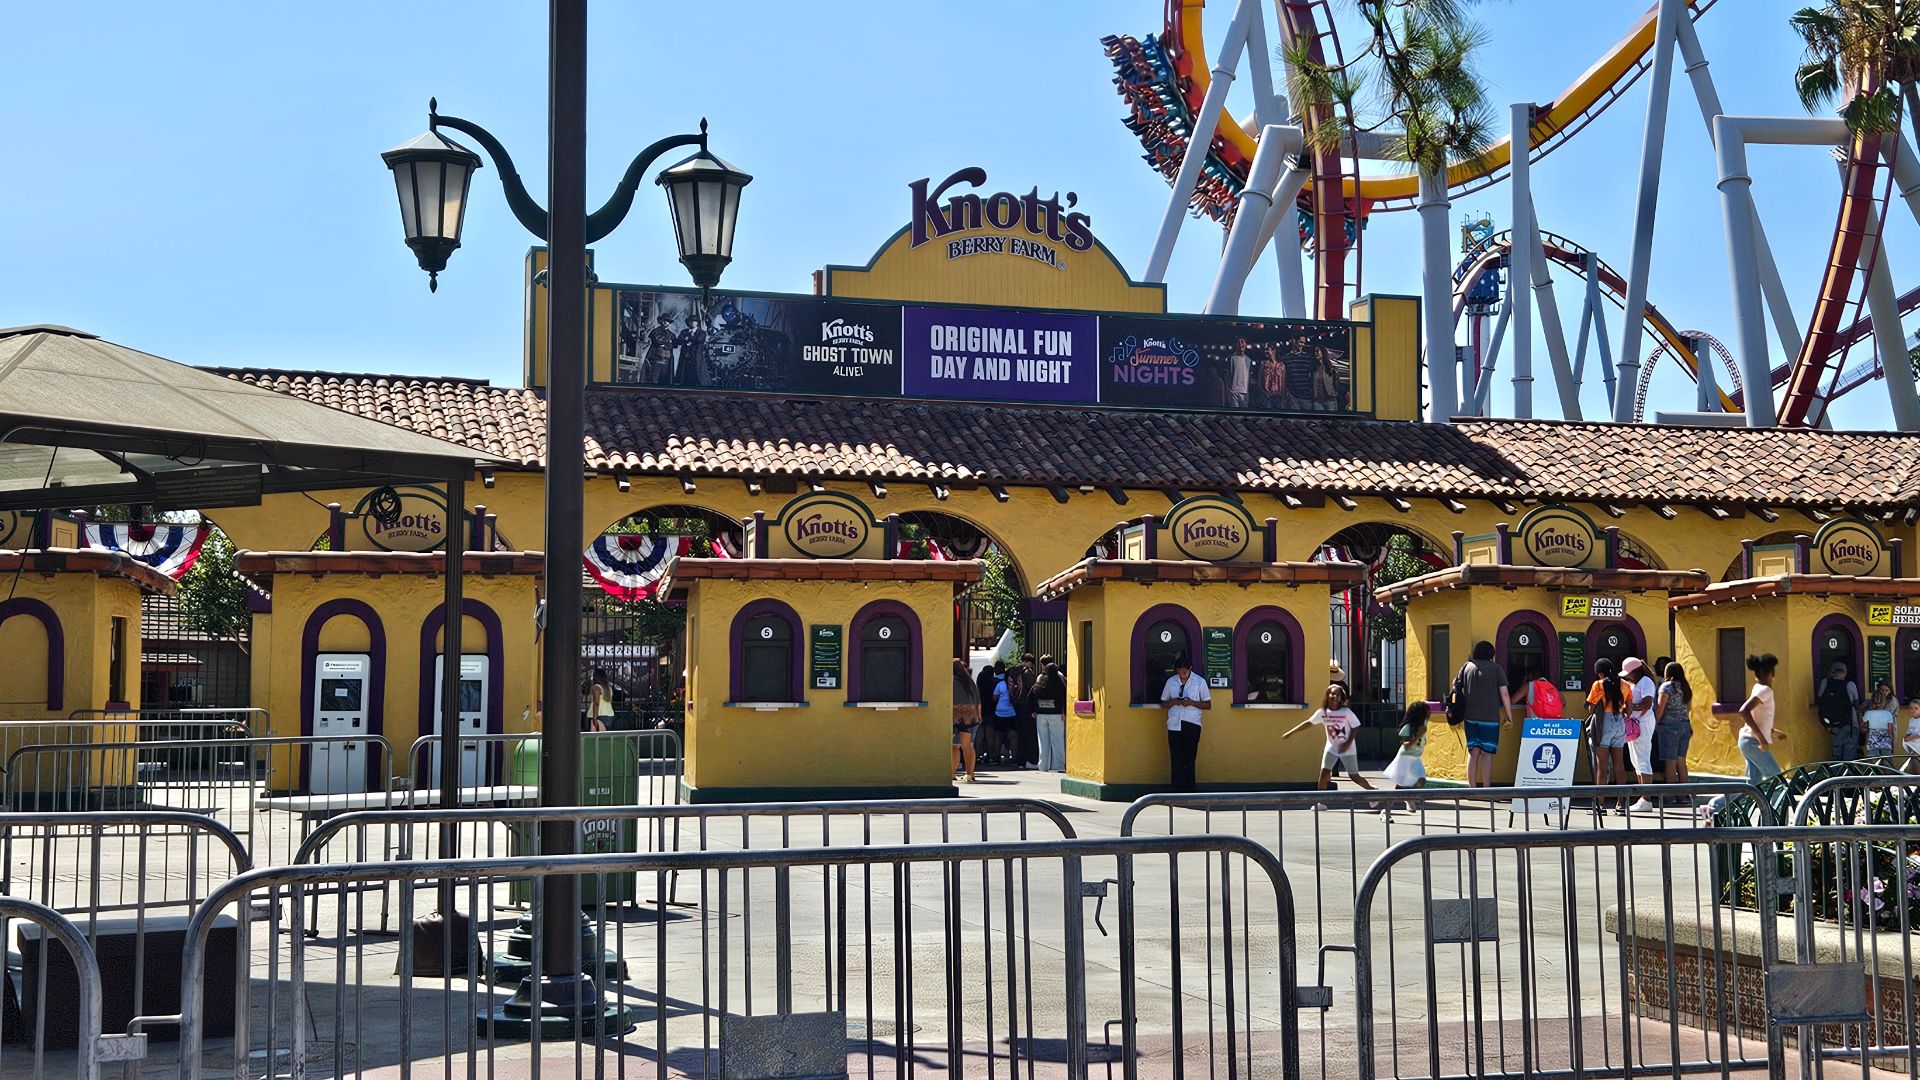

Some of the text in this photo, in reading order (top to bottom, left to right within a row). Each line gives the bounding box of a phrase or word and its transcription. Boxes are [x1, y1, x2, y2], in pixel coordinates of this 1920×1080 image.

[907, 166, 1095, 252] Knott's
[946, 236, 1058, 268] BERRY FARM
[821, 318, 874, 342] Knott's
[930, 324, 1072, 357] ORIGINAL FUN
[803, 345, 893, 365] GHOST TOWN
[1130, 348, 1179, 367] Summer
[832, 365, 864, 377] ALIVE!
[930, 355, 1072, 384] DAY AND NIGHT
[1113, 364, 1195, 386] NIGHTS
[796, 513, 859, 541] Knott's
[1183, 517, 1241, 544] Knott's
[1534, 527, 1585, 553] Knott's
[1829, 538, 1873, 562] Knott's
[1590, 607, 1623, 617] HERE
[1592, 597, 1623, 608] SOLD
[1893, 605, 1920, 615] SOLD
[1530, 727, 1573, 736] CASHLESS
